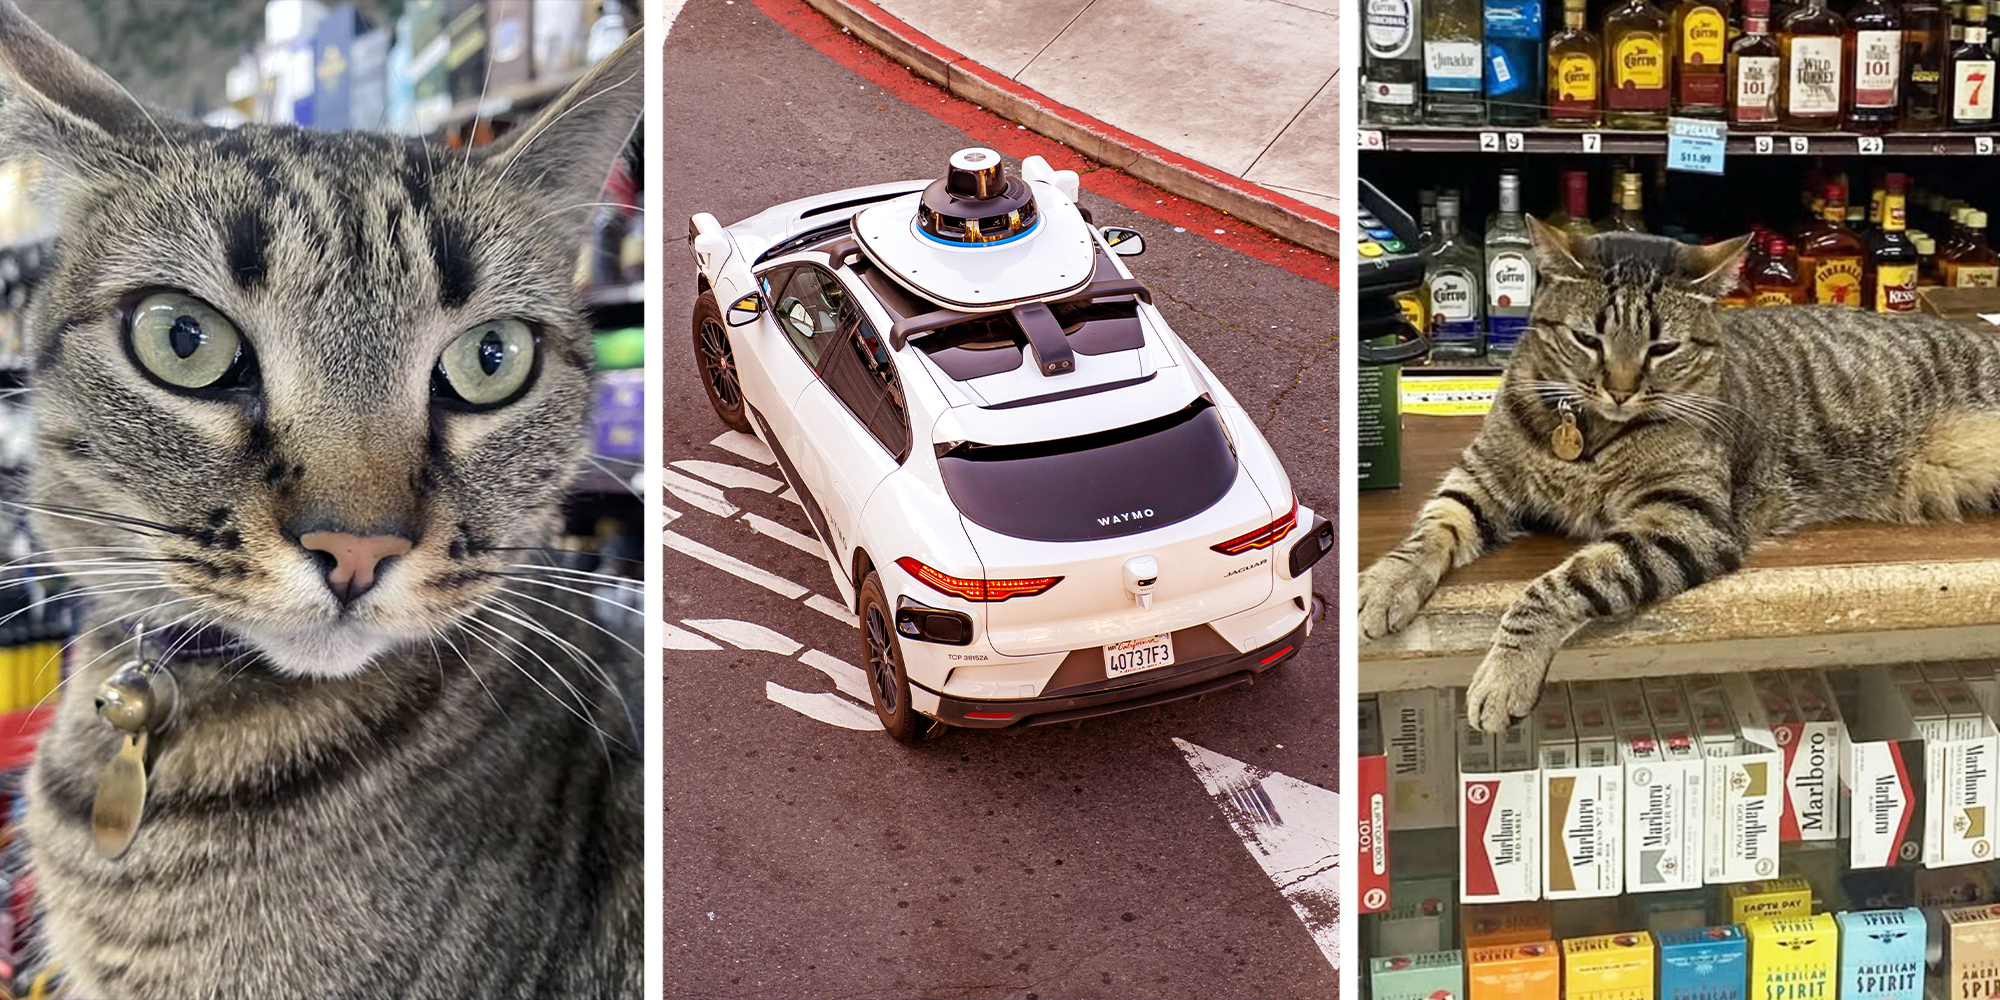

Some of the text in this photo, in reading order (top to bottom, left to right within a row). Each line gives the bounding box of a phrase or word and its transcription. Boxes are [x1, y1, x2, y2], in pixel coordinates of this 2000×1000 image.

[1803, 57, 1831, 71] WILD
[1865, 61, 1890, 76] 101
[1797, 68, 1835, 84] TURKEY
[1743, 82, 1765, 94] 101
[1966, 73, 1986, 106] 7
[1675, 122, 1720, 138] SPECIAL
[1484, 135, 1519, 150] 2 9
[1588, 137, 1597, 150] 7
[1759, 139, 1769, 152] 9
[1795, 139, 1805, 152] 6
[1979, 140, 1989, 153] 5
[1681, 152, 1712, 164] $11.99
[1097, 508, 1154, 527] WAYMO
[1223, 559, 1268, 578] JAGUAR
[947, 653, 962, 661] TCP
[1110, 644, 1169, 672] 40737F3
[1391, 708, 1417, 775] Marlboro
[1795, 732, 1825, 832] Marlboro
[1964, 744, 1988, 805] Marlboro
[1875, 774, 1898, 835] Marlboro
[1639, 784, 1664, 847] Marlboro
[1663, 783, 1673, 846] SILVER PACK
[1491, 808, 1514, 867] Marlboro
[1514, 811, 1522, 862] RED LABEL
[1568, 798, 1595, 867] Marlboro
[1735, 803, 1744, 858] GOLD PACK
[1745, 799, 1768, 861] Marlboro
[1375, 845, 1383, 867] BOX
[1743, 899, 1802, 913] EARTH DAY
[1773, 922, 1815, 933] SPIRIT
[1864, 915, 1905, 926] SPIRIT
[1766, 969, 1827, 982] AMERICAN
[1857, 962, 1917, 975] AMERICAN
[1766, 981, 1826, 1000] SPIRIT
[1856, 973, 1916, 993] SPIRIT
